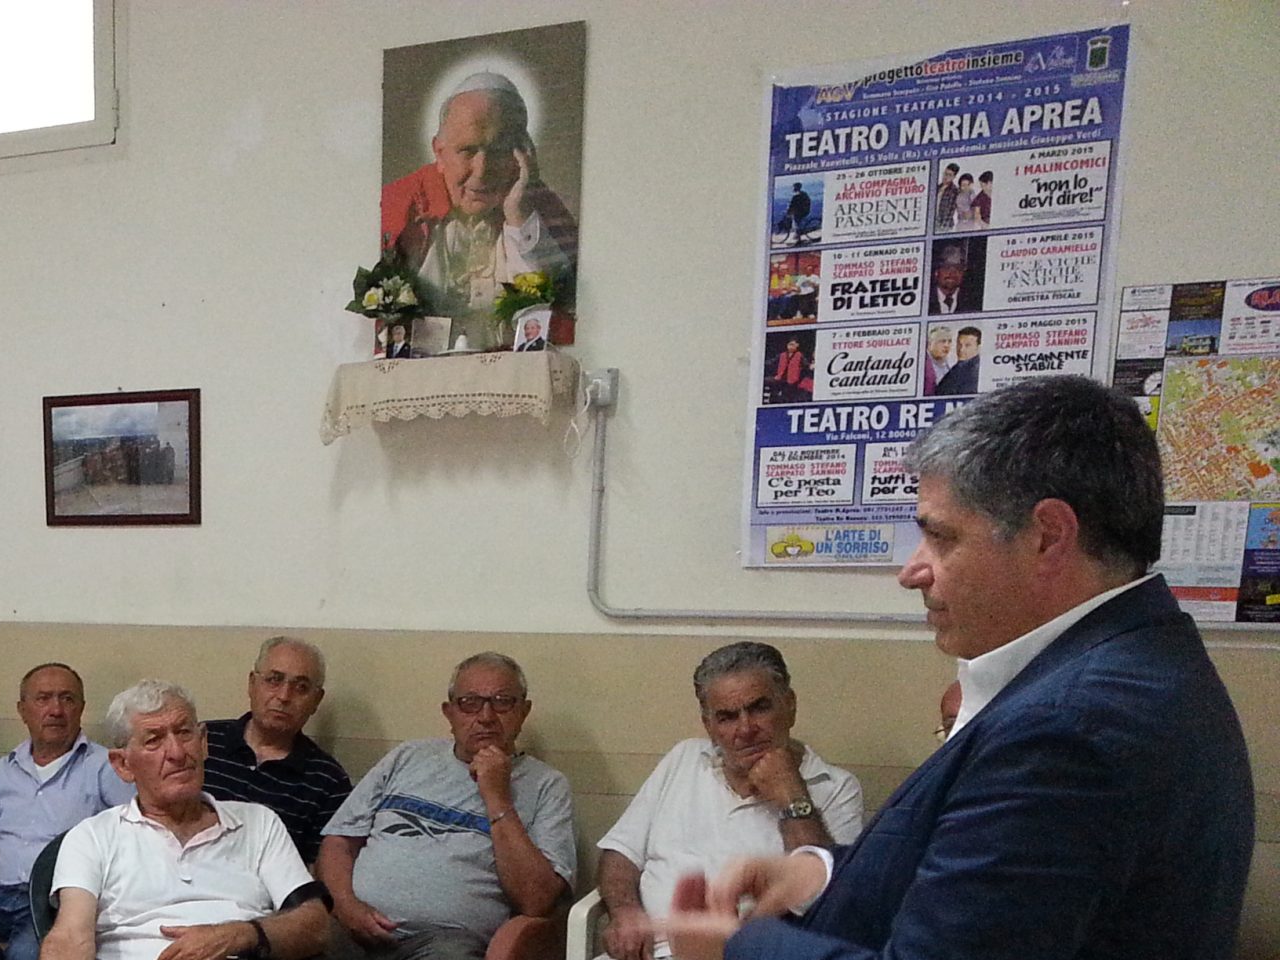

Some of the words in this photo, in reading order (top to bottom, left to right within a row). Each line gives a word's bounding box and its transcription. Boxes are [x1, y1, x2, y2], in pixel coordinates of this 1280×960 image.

[825, 105, 888, 122] STAGIONE
[895, 97, 961, 114] TEATRALE
[968, 91, 1003, 104] 2014
[1024, 84, 1061, 98] 2015
[785, 123, 889, 159] TEATRO
[899, 111, 991, 147] MARIA
[1000, 96, 1103, 136] APREA
[1076, 128, 1102, 139] Verdi
[1038, 149, 1068, 158] MARZO
[868, 167, 903, 177] OTTOBRE
[906, 165, 926, 174] 2014
[1024, 156, 1106, 175] MALINCOMICI
[844, 182, 856, 192] LA
[859, 176, 917, 190] COMPAGNIA
[1073, 174, 1088, 190] lo
[835, 189, 882, 201] ARCHIVIO
[885, 184, 926, 196] FUTURO
[1019, 192, 1053, 209] devi
[1039, 233, 1068, 243] APRILE
[1072, 232, 1094, 240] 2015
[863, 248, 898, 257] GENNAIO
[900, 246, 920, 254] 2015
[1000, 248, 1038, 258] CLAUDIO
[833, 261, 875, 271] TOMMASO
[880, 257, 918, 267] STEFANO
[833, 269, 875, 279] SCARPATO
[879, 266, 918, 275] SANNINO
[830, 276, 919, 297] FRATELLI
[833, 296, 852, 311] DI
[859, 291, 917, 309] LETTO
[1007, 294, 1049, 303] ORCHESTRA
[1030, 319, 1062, 328] MAGGIO
[1065, 318, 1087, 326] 2015
[852, 328, 890, 337] FEBBRAIO
[893, 327, 913, 335] 2015
[996, 331, 1040, 342] TOMMASO
[1046, 329, 1087, 338] STEFANO
[832, 340, 864, 350] ETTORE
[866, 338, 911, 349] SQUILLACE
[995, 340, 1040, 350] SCARPATO
[1045, 338, 1087, 347] SANNINO
[827, 351, 915, 375] Cantando
[1015, 359, 1064, 373] STABILE
[829, 368, 911, 388] cantando
[787, 404, 890, 434] TEATRO
[898, 402, 935, 429] RE
[825, 433, 839, 441] Via
[875, 431, 886, 439] 12
[888, 430, 916, 438] 80040
[766, 463, 805, 471] TOMMASO
[811, 462, 847, 470] STEFANO
[797, 477, 841, 490] posta
[871, 473, 905, 485] tutti
[774, 489, 801, 500] per
[805, 487, 835, 497] Teo
[870, 486, 898, 497] per
[825, 530, 864, 541] L'ARTE
[869, 529, 881, 540] DI
[816, 543, 833, 554] UN
[836, 542, 889, 554] SORRISO
